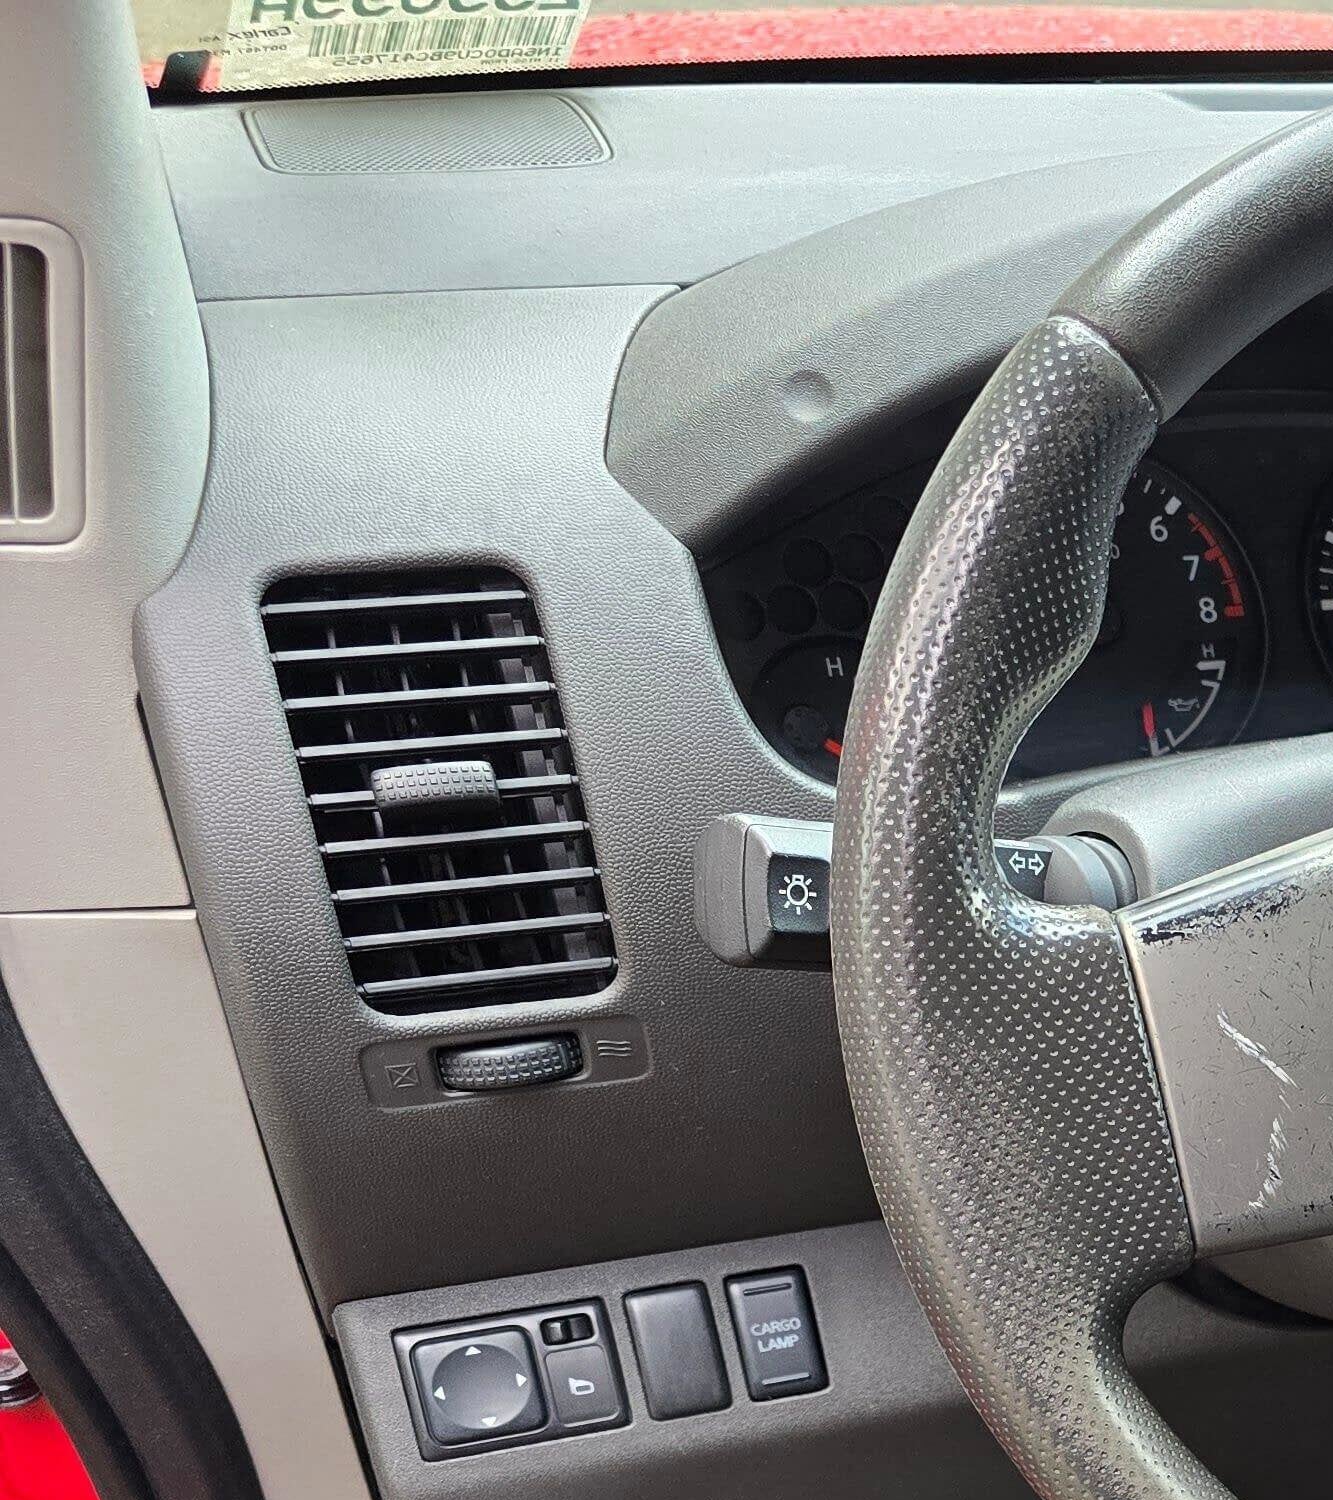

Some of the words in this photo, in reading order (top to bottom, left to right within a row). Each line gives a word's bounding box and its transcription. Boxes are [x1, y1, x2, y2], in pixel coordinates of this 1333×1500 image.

[1150, 515, 1168, 542] 6
[1182, 555, 1200, 582] 7
[1199, 597, 1218, 624] 8
[825, 656, 844, 677] H
[751, 1316, 802, 1336] CARGO
[758, 1333, 798, 1353] LAMP
